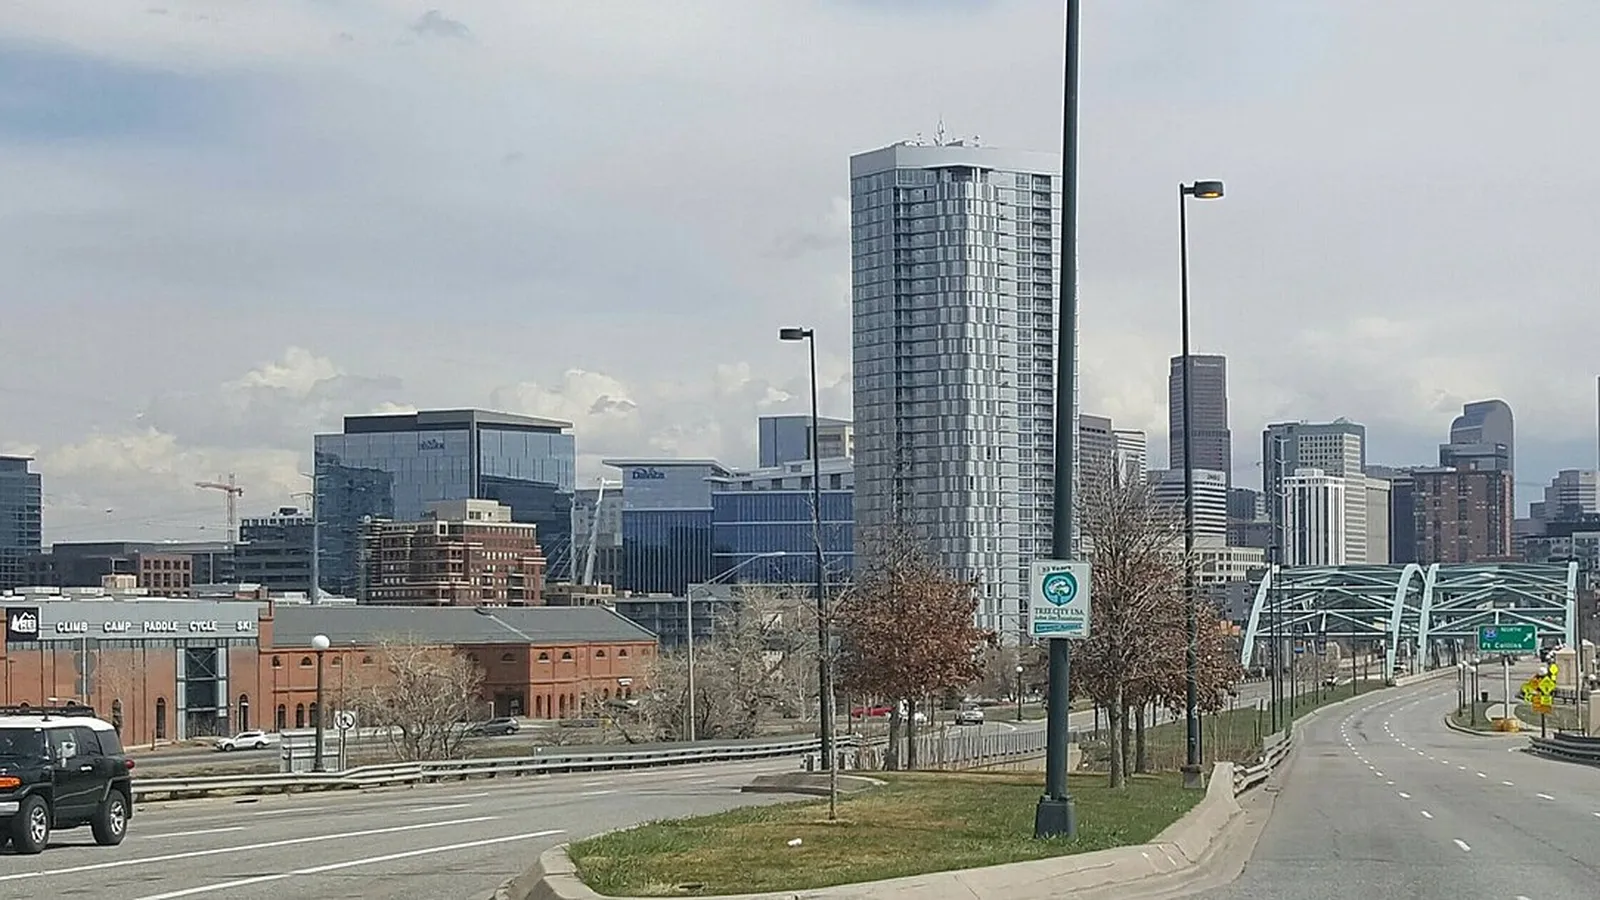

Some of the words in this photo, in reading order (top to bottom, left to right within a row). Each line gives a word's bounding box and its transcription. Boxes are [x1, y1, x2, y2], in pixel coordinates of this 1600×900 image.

[57, 621, 88, 633] CLIMB
[104, 621, 132, 632] CAMP
[143, 621, 179, 632] PADDLE
[189, 620, 218, 631] CYCLE
[236, 620, 252, 631] SKI
